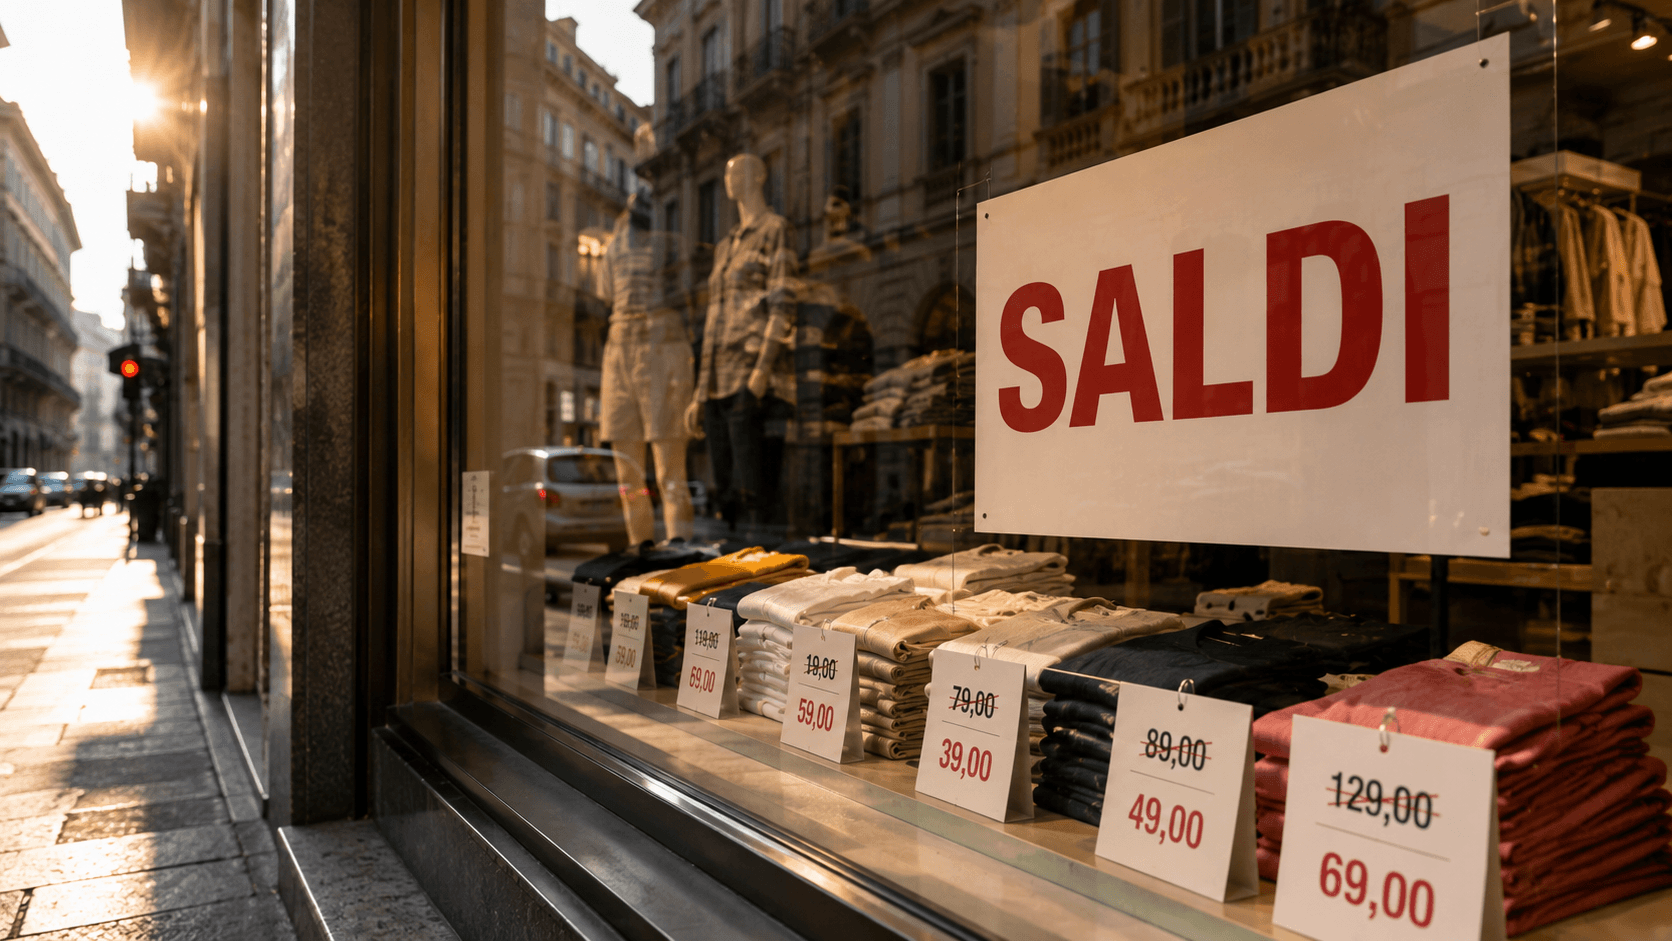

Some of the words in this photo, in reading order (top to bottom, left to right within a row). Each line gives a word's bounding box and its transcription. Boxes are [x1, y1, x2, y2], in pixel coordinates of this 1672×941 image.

[998, 194, 1450, 433] SALDI
[695, 629, 719, 650] 119,00
[690, 666, 716, 693] 69,00
[797, 698, 834, 732] 59,00
[951, 685, 995, 719] 79,00
[939, 738, 993, 782] 39,00
[1145, 728, 1207, 771] 89,00
[1128, 793, 1205, 850] 49,00
[1331, 772, 1433, 829] 129,00
[1319, 851, 1435, 929] 69,00
